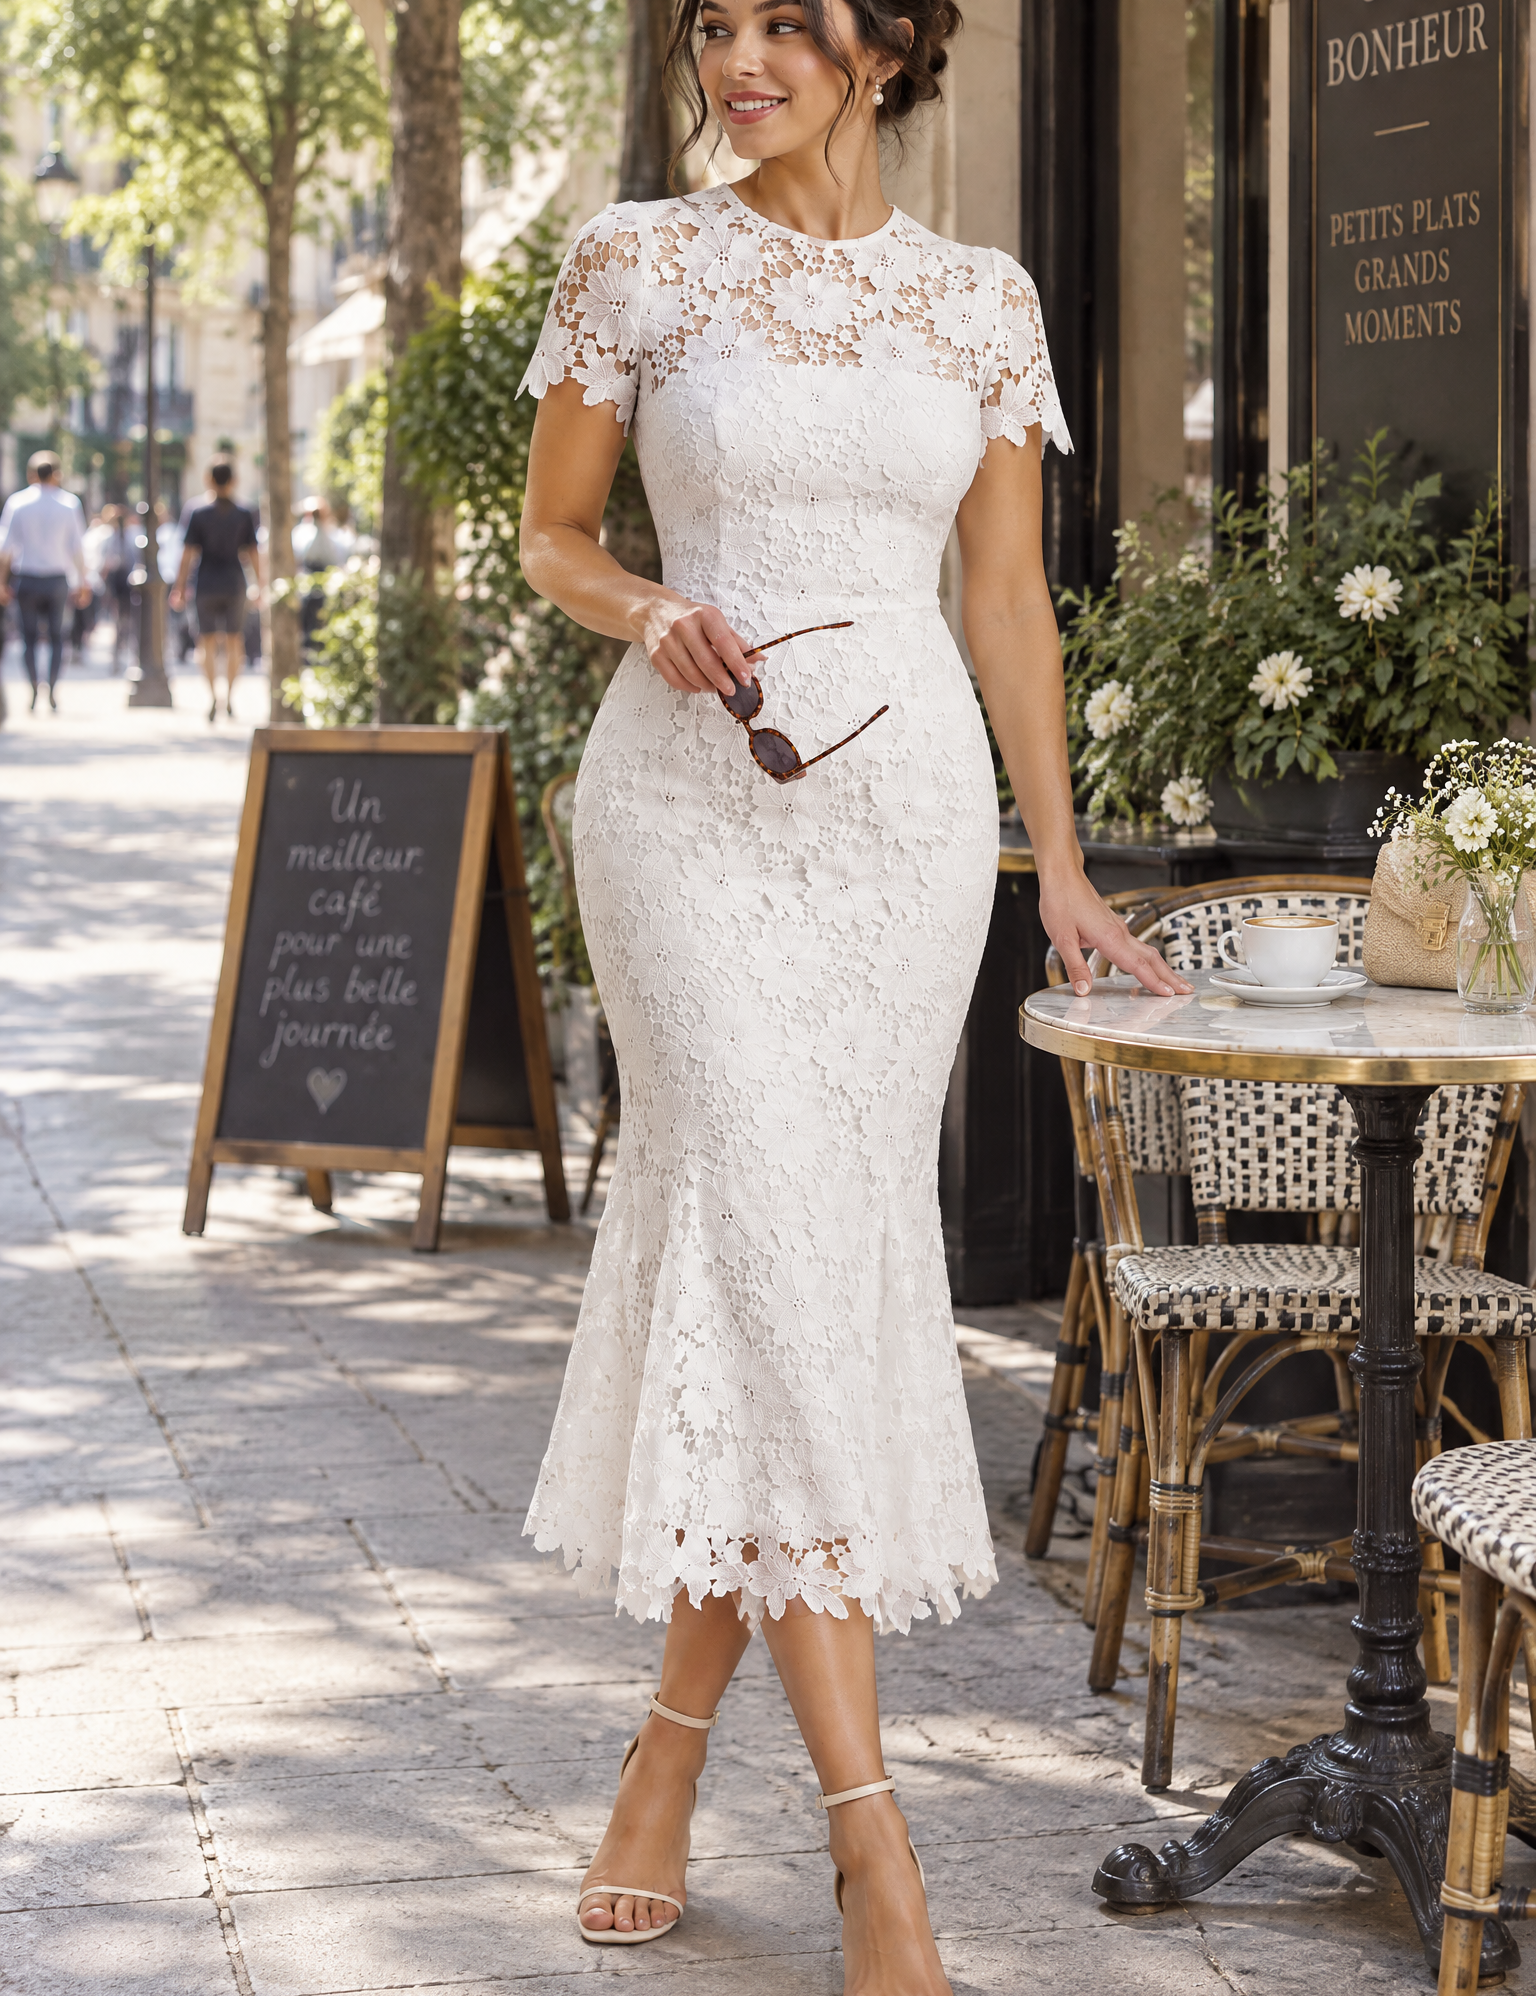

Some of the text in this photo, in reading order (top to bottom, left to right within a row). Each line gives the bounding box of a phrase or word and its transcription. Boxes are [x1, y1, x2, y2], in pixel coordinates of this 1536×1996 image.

[1326, 2, 1488, 87] BONHEUR
[1330, 190, 1481, 247] PETITS PLATS
[1354, 248, 1450, 293] GRANDS
[1344, 299, 1462, 346] MOMENTS
[327, 777, 386, 823] Un
[308, 875, 382, 932] café
[268, 930, 413, 972] pour une
[259, 962, 419, 1017] plus belle
[258, 1008, 397, 1069] journée
